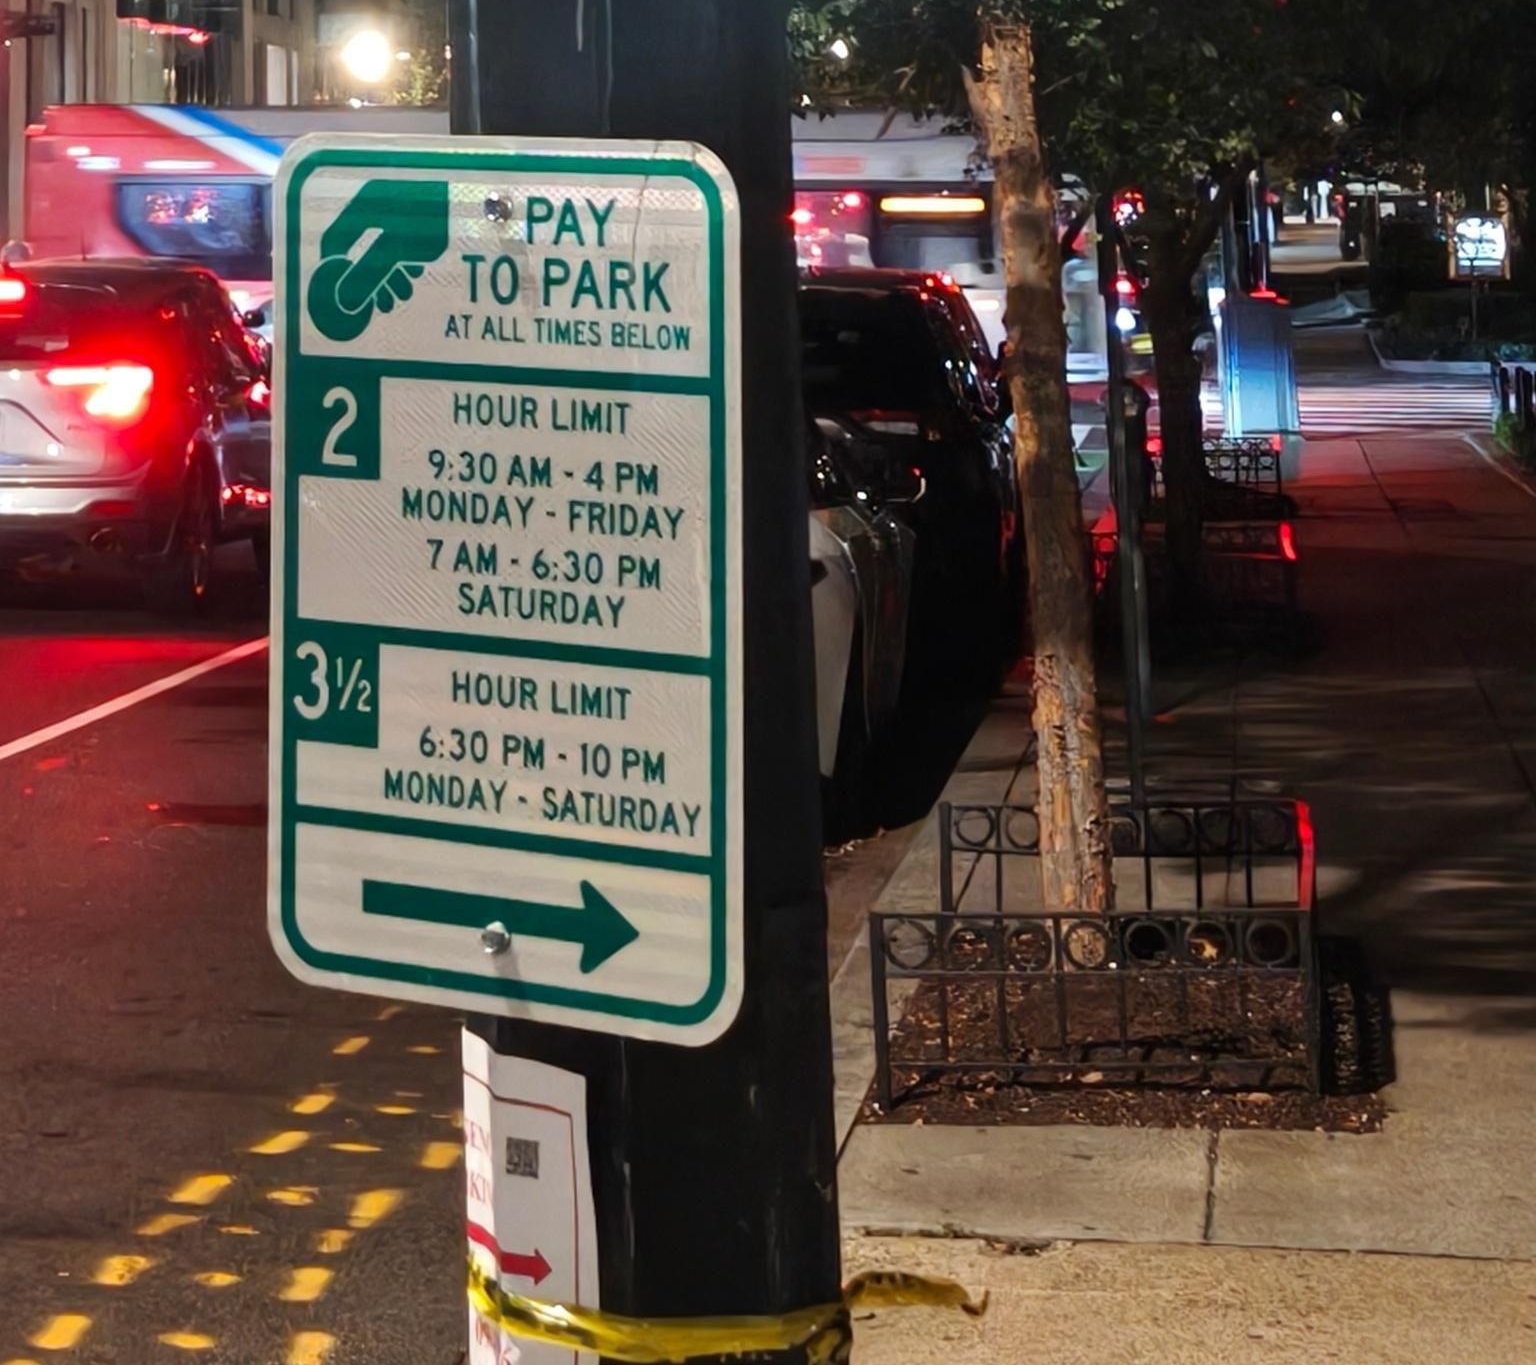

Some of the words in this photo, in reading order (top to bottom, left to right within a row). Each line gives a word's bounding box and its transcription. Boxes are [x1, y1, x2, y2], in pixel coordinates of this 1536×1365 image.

[525, 195, 617, 249] PAY
[461, 254, 519, 303] TO
[541, 256, 672, 314] PARK
[444, 314, 473, 339] AT
[480, 316, 525, 343] ALL
[534, 318, 604, 348] TIMES
[611, 322, 692, 351] BELOW
[322, 387, 358, 467] 2
[453, 392, 537, 430] HOUR
[552, 397, 631, 435] LIMIT
[428, 450, 497, 486] 9:30
[505, 453, 552, 489] AM
[585, 459, 604, 492] 4
[615, 462, 659, 497] PM
[402, 484, 532, 529] MONDAY
[567, 498, 685, 540] FRIDAY
[426, 540, 442, 571] 7
[452, 542, 499, 576] AM
[531, 549, 606, 585] 6:30
[617, 555, 662, 590] PM
[458, 583, 627, 628] SATURDAY
[450, 672, 538, 714] HOUR
[550, 682, 632, 720] LIMIT
[419, 727, 490, 760] 6:30
[502, 736, 550, 771] PM
[579, 741, 611, 779] 10
[620, 747, 666, 784] PM
[384, 770, 505, 812] MONDAY
[542, 788, 701, 837] SATURDAY
